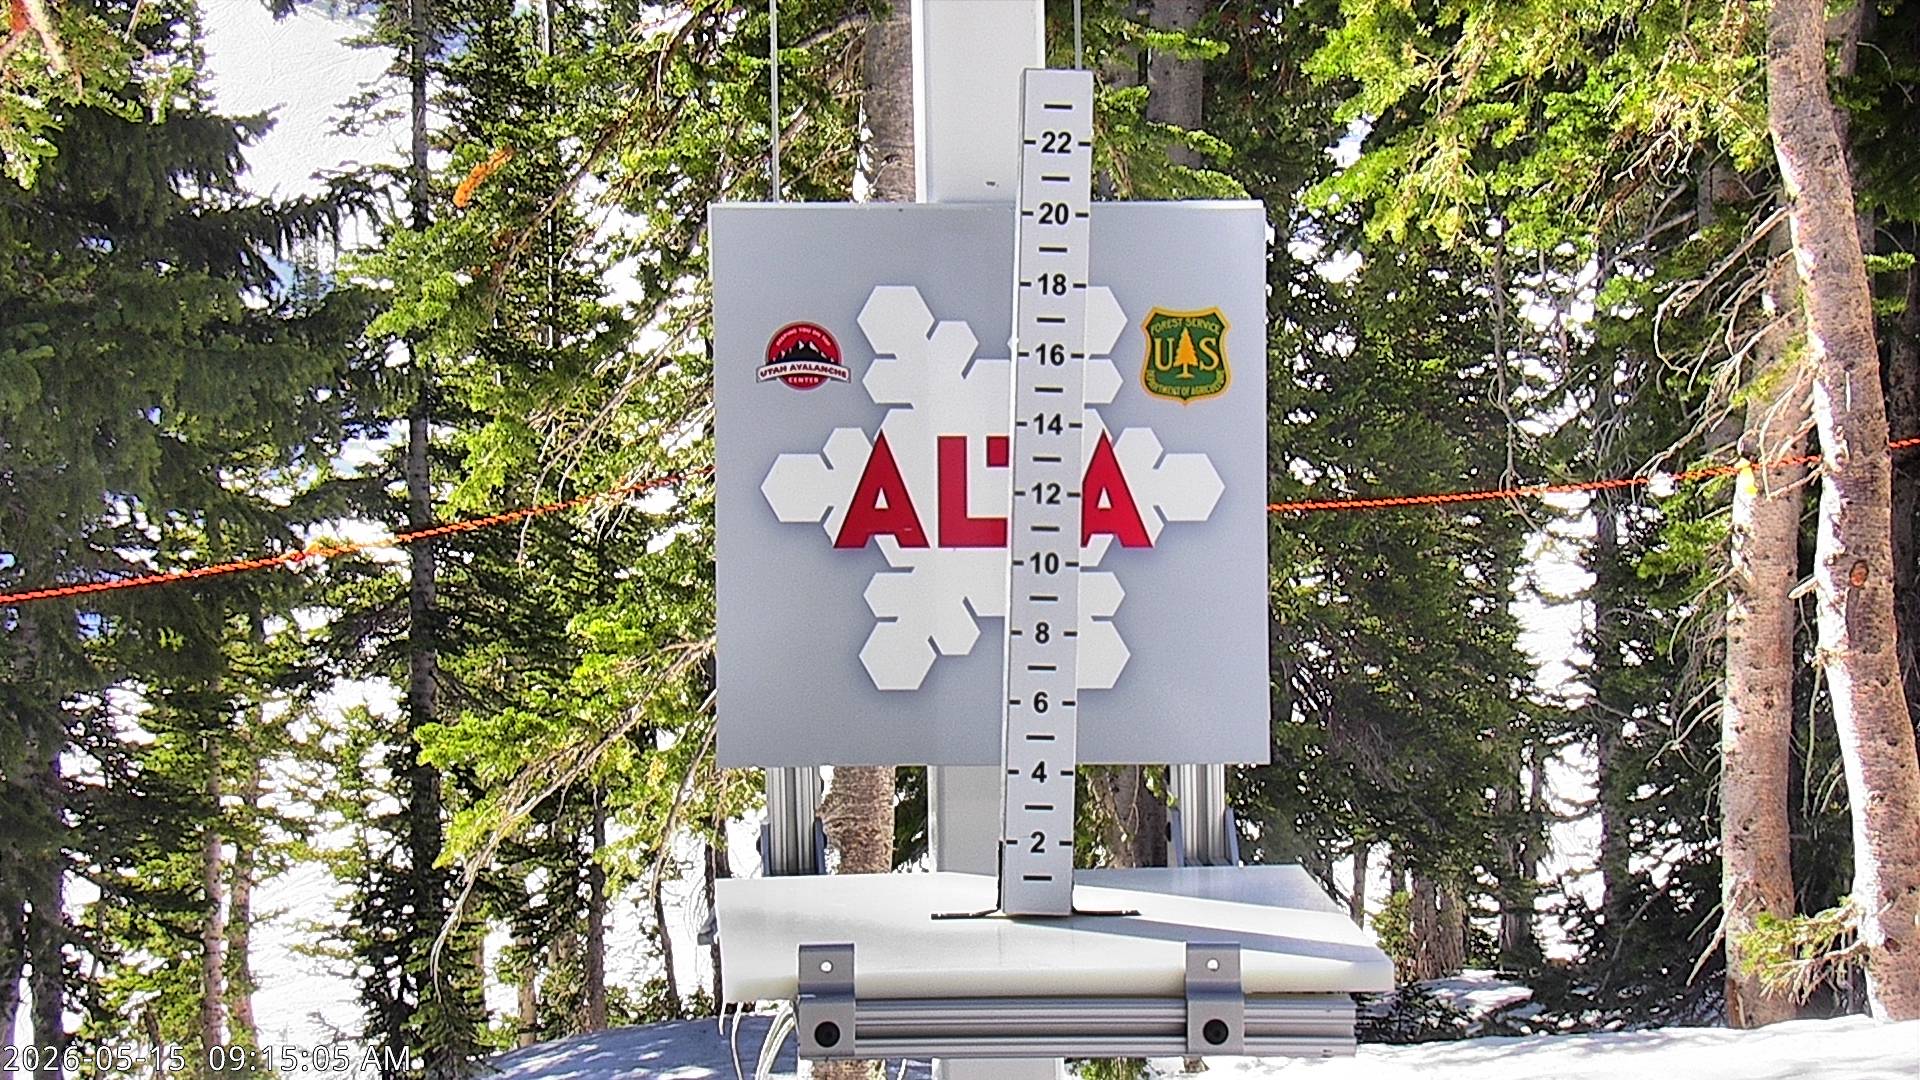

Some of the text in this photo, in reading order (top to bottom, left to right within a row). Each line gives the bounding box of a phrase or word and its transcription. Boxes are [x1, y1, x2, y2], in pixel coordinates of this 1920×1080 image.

[1041, 131, 1072, 154] 22
[1038, 202, 1069, 226] 20
[1037, 273, 1067, 296] 18
[1150, 317, 1220, 336] FOREST SERVICE
[1035, 343, 1065, 367] 16
[760, 363, 847, 378] UTAH AVALANCHE
[1033, 412, 1064, 436] 14
[834, 429, 1153, 548] ALA
[1031, 482, 1061, 505] 12
[1030, 551, 1059, 575] 10
[1035, 621, 1050, 645] 8
[1033, 691, 1049, 714] 6
[1031, 760, 1048, 784] 4
[1030, 831, 1046, 854] 2
